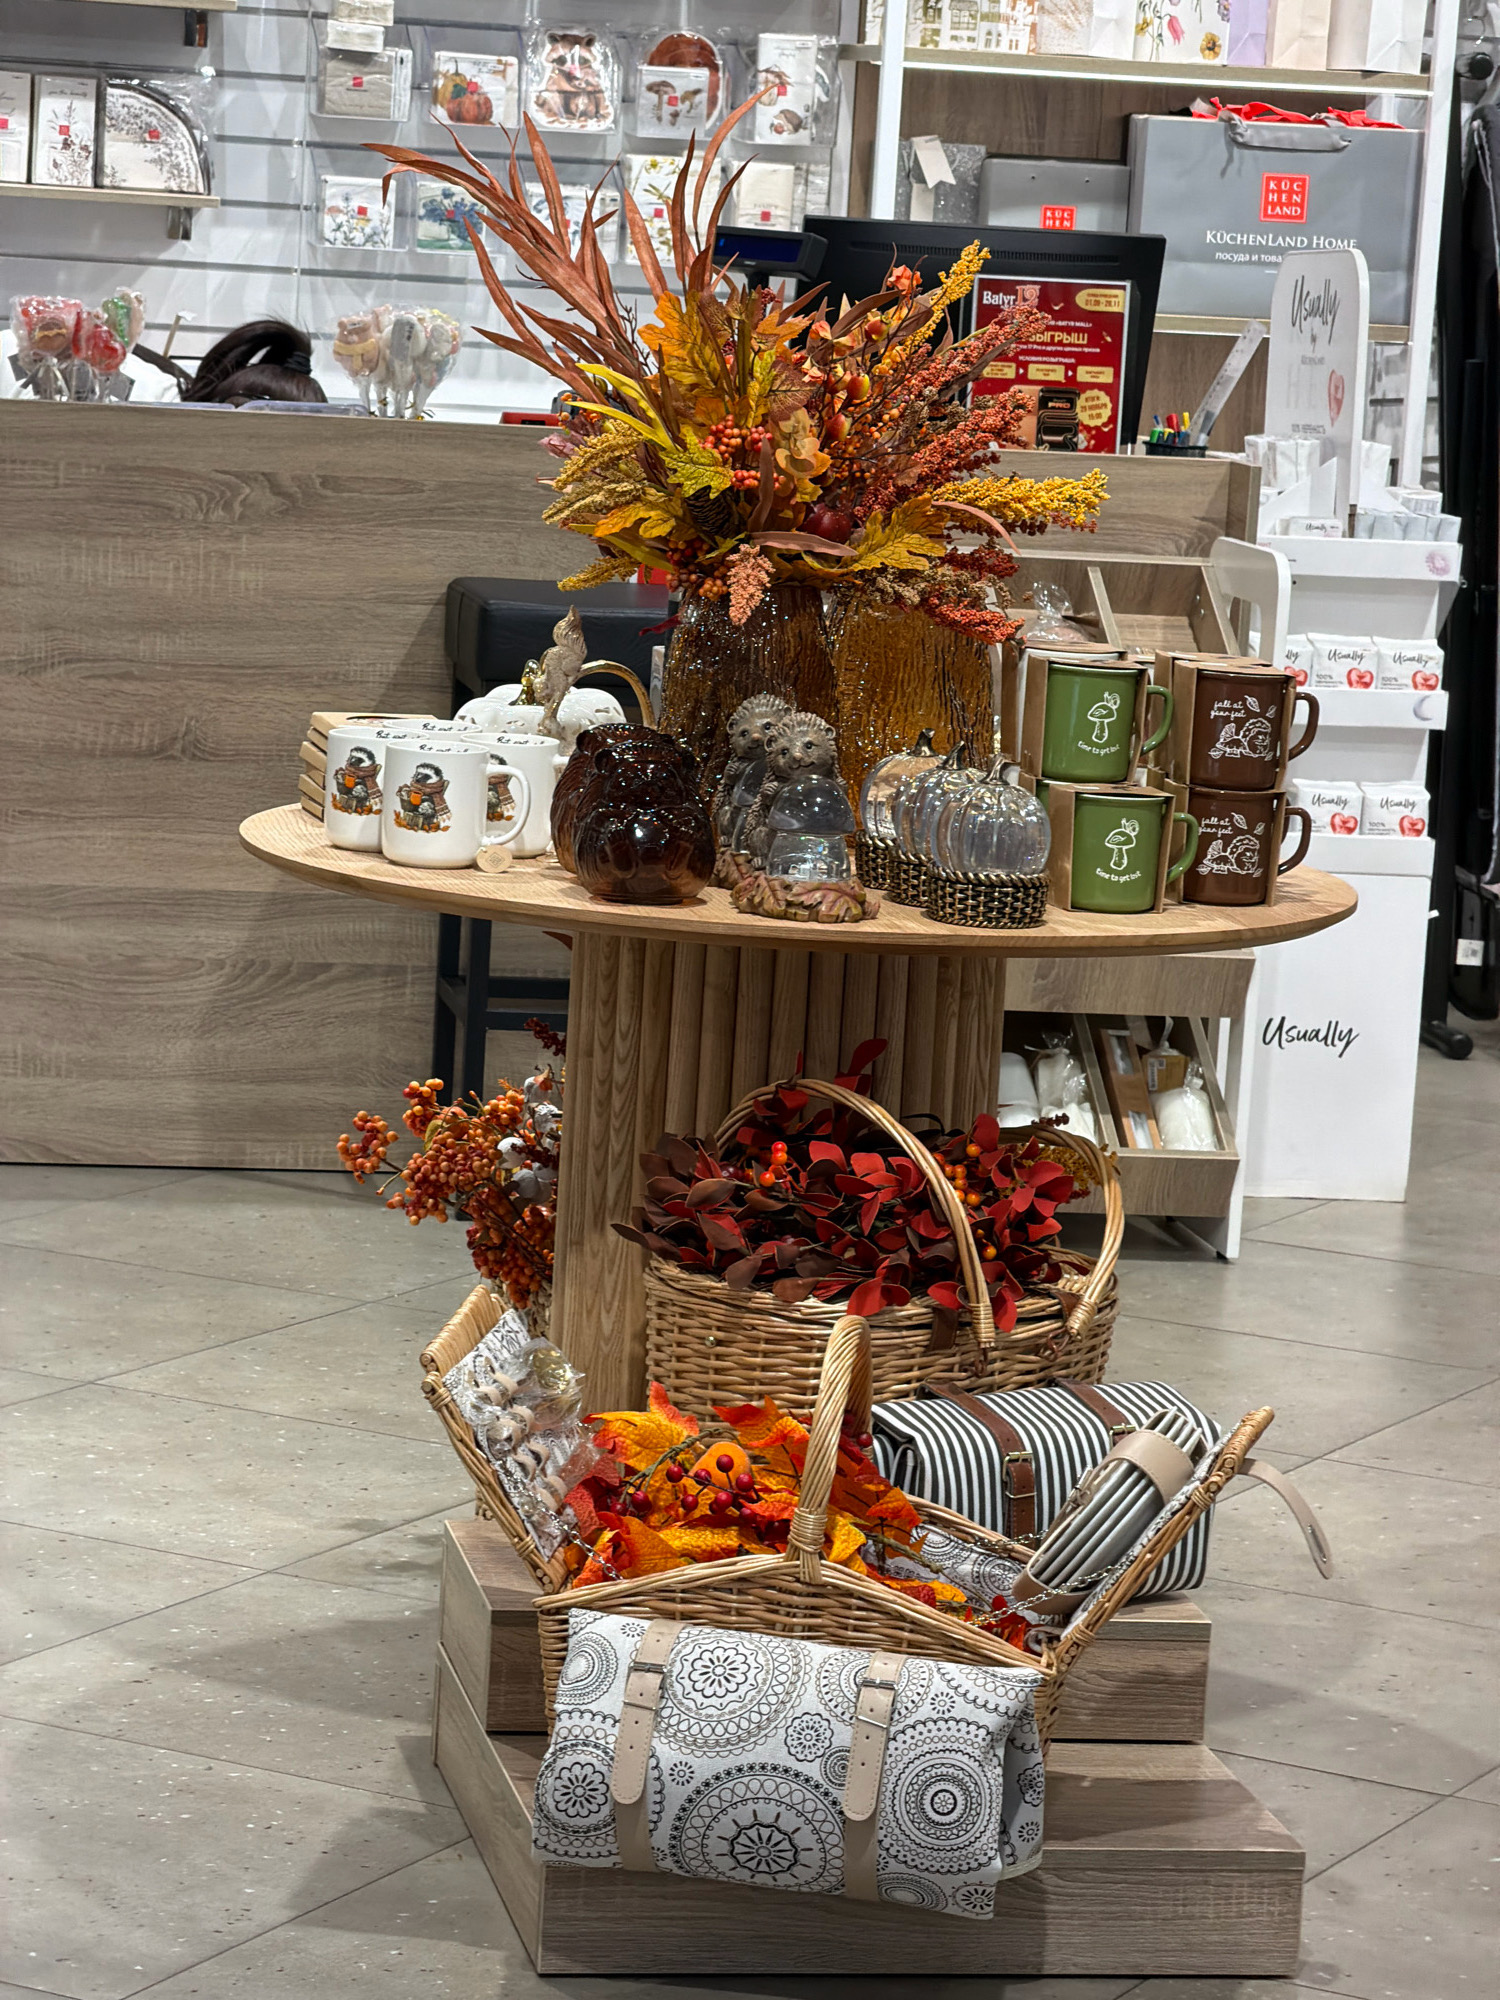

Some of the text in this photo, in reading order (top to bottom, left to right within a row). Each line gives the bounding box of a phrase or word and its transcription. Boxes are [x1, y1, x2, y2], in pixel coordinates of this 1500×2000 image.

[1269, 179, 1303, 192] KÜC
[1268, 192, 1302, 204] HEN
[1267, 204, 1301, 217] LAND
[1215, 251, 1283, 263] посуда и това
[982, 290, 1016, 309] Batyr
[1291, 274, 1341, 346] Usually
[1026, 330, 1088, 345] ЗЫГРЫШ
[1327, 648, 1366, 665] Usually
[1392, 651, 1429, 667] Usually
[1311, 793, 1350, 811] Usually
[1379, 796, 1417, 813] Usually
[1095, 867, 1110, 880] time
[1261, 1015, 1360, 1059] Usually
